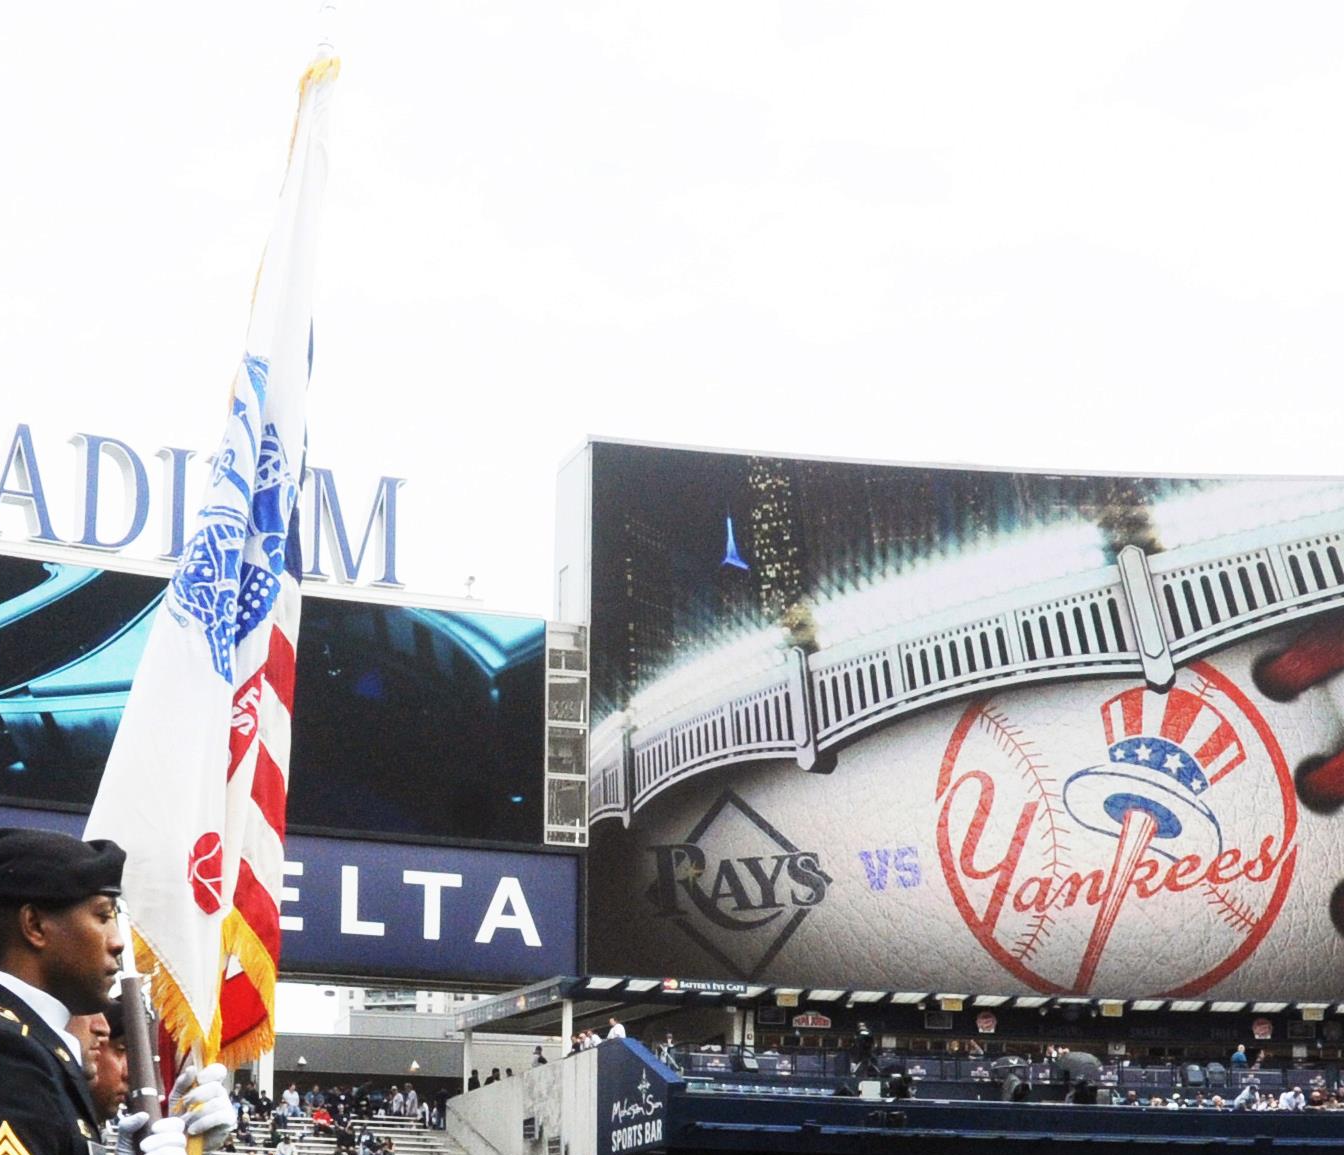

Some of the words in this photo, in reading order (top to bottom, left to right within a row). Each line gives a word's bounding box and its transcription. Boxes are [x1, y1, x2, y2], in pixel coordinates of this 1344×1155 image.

[649, 842, 832, 920] RAYS
[857, 845, 922, 891] VS
[945, 768, 1277, 938] Yankees
[278, 860, 543, 948] ELTA
[611, 1123, 643, 1153] SPORTS
[644, 1118, 663, 1143] BAR
